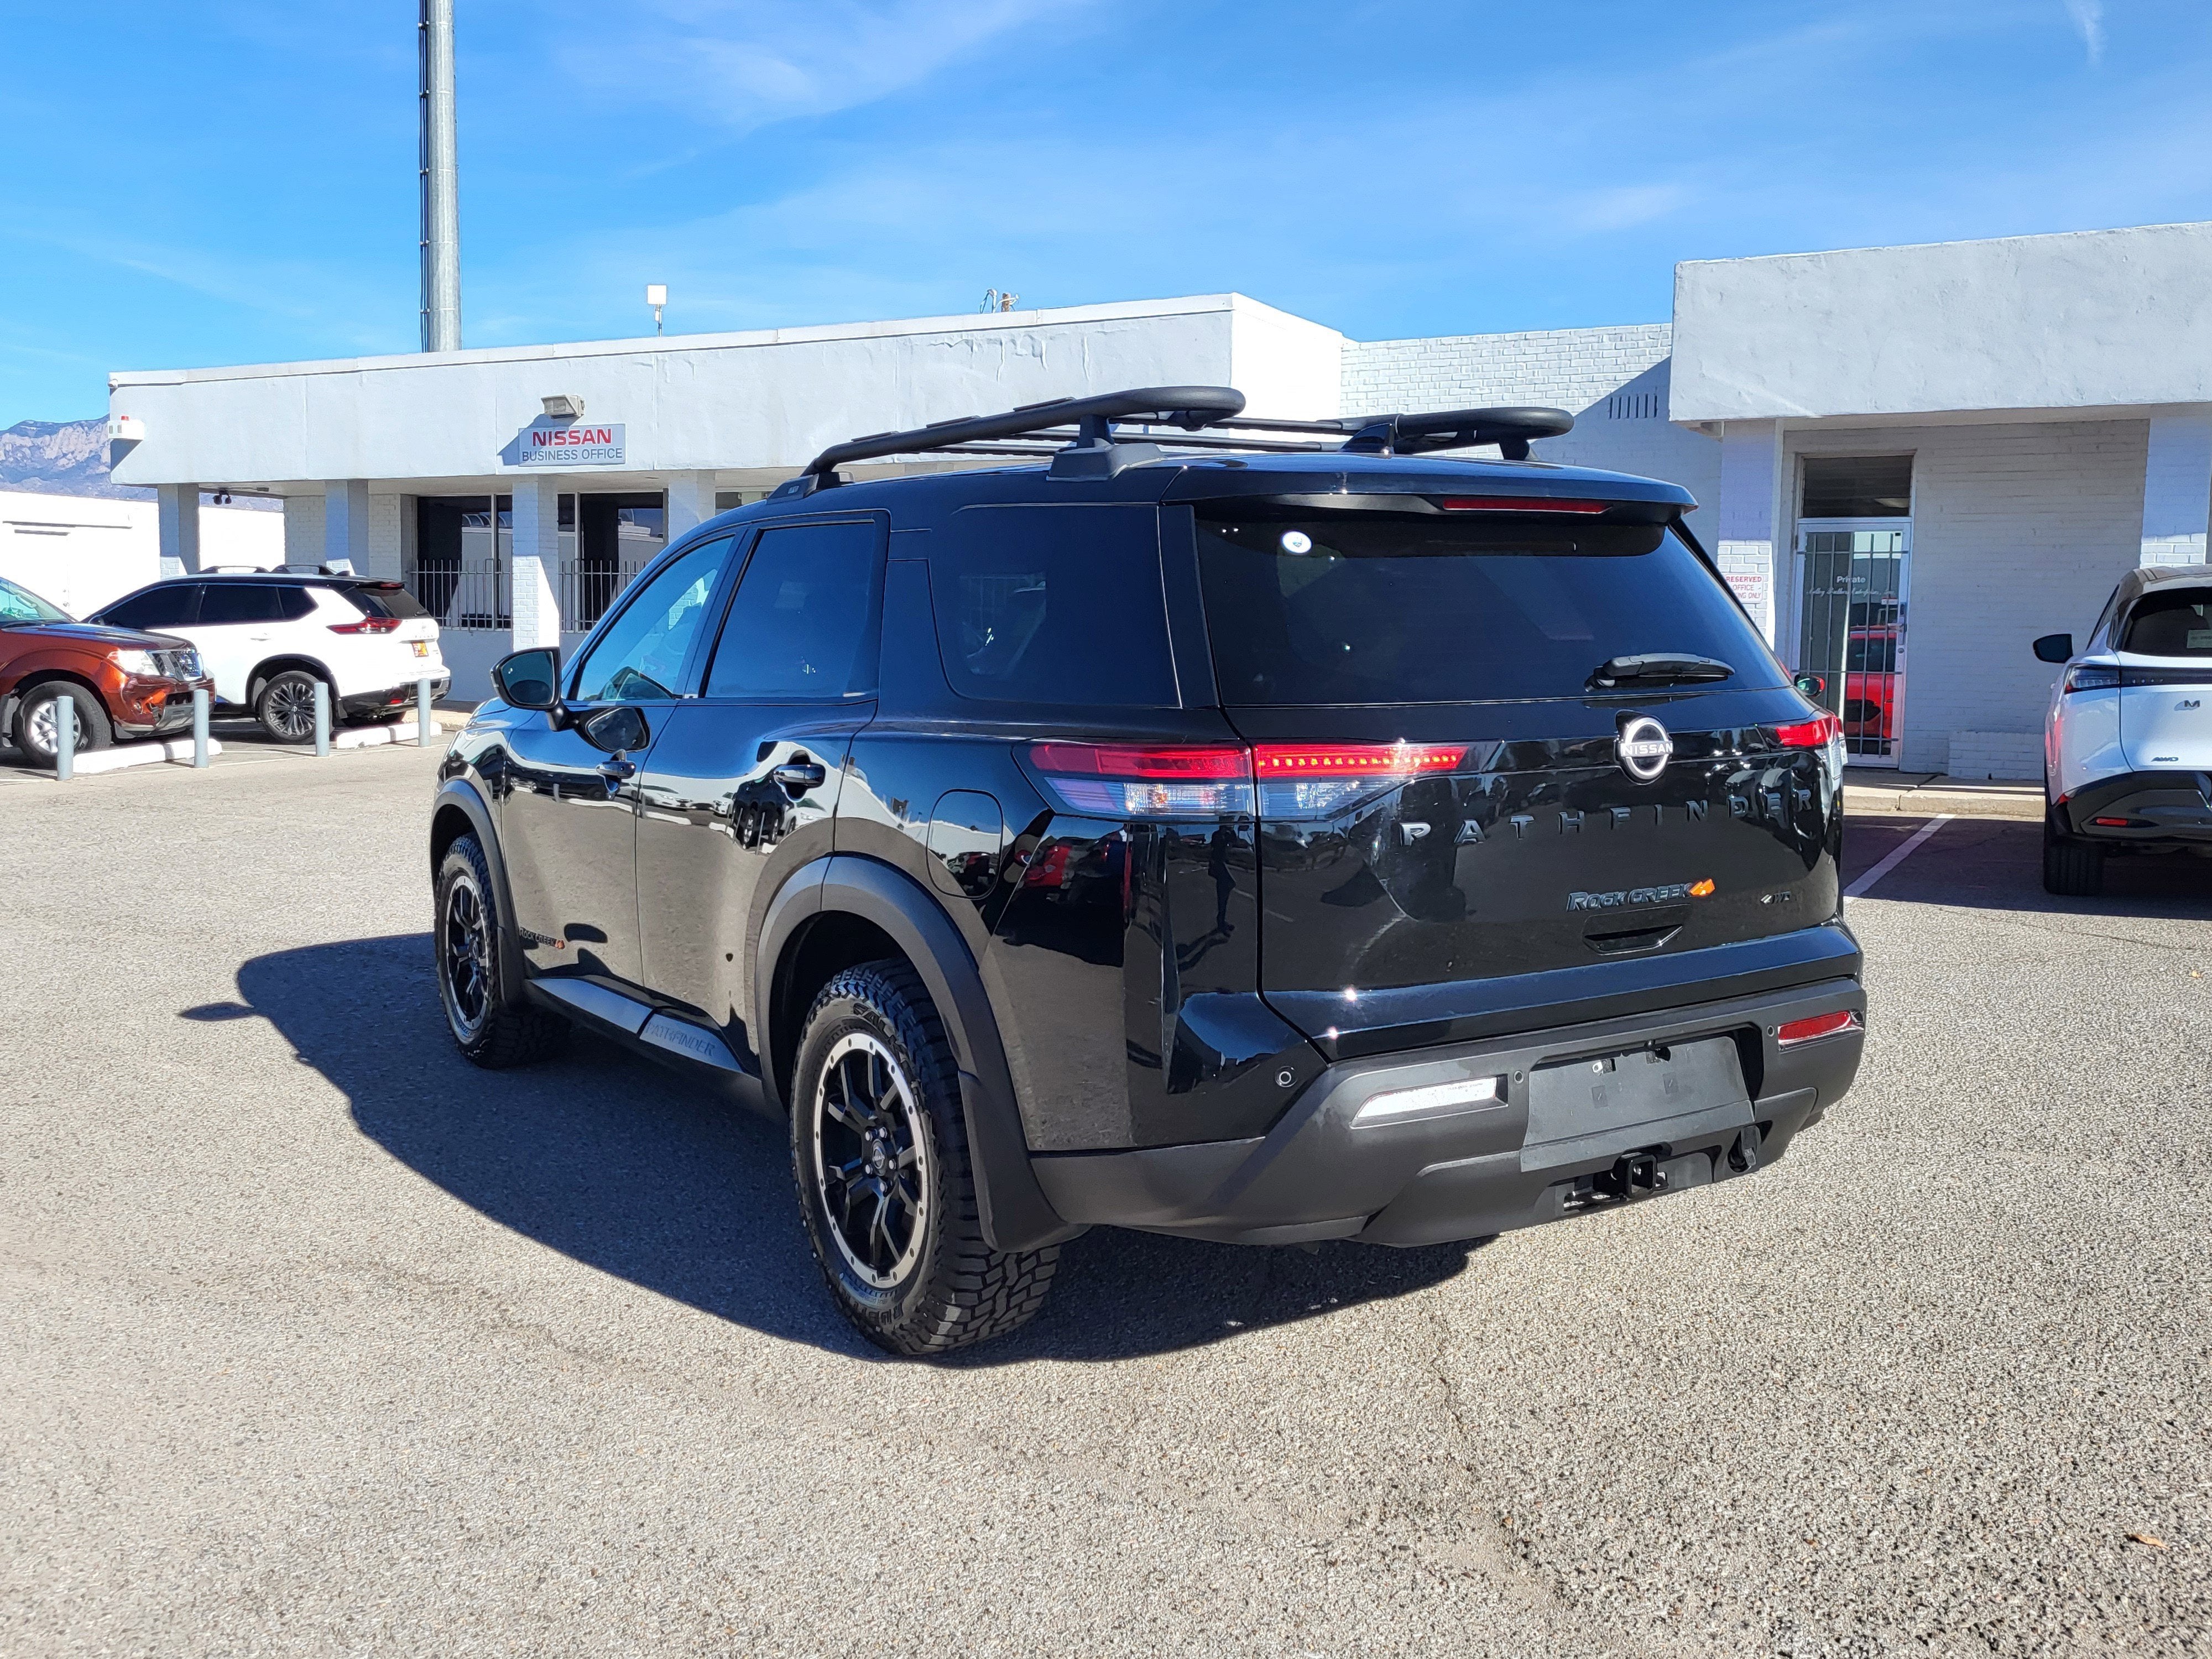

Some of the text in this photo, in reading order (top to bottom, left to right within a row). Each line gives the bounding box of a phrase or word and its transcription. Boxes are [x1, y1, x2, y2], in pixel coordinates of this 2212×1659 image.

[532, 428, 612, 447] NISSAN
[521, 447, 623, 462] BUSINESS OFFICE
[1621, 742, 1673, 756] NISSAN
[1399, 789, 1813, 847] PATHFINDER
[1566, 882, 1693, 912] ROCK CREEK
[519, 927, 536, 941] ROCK
